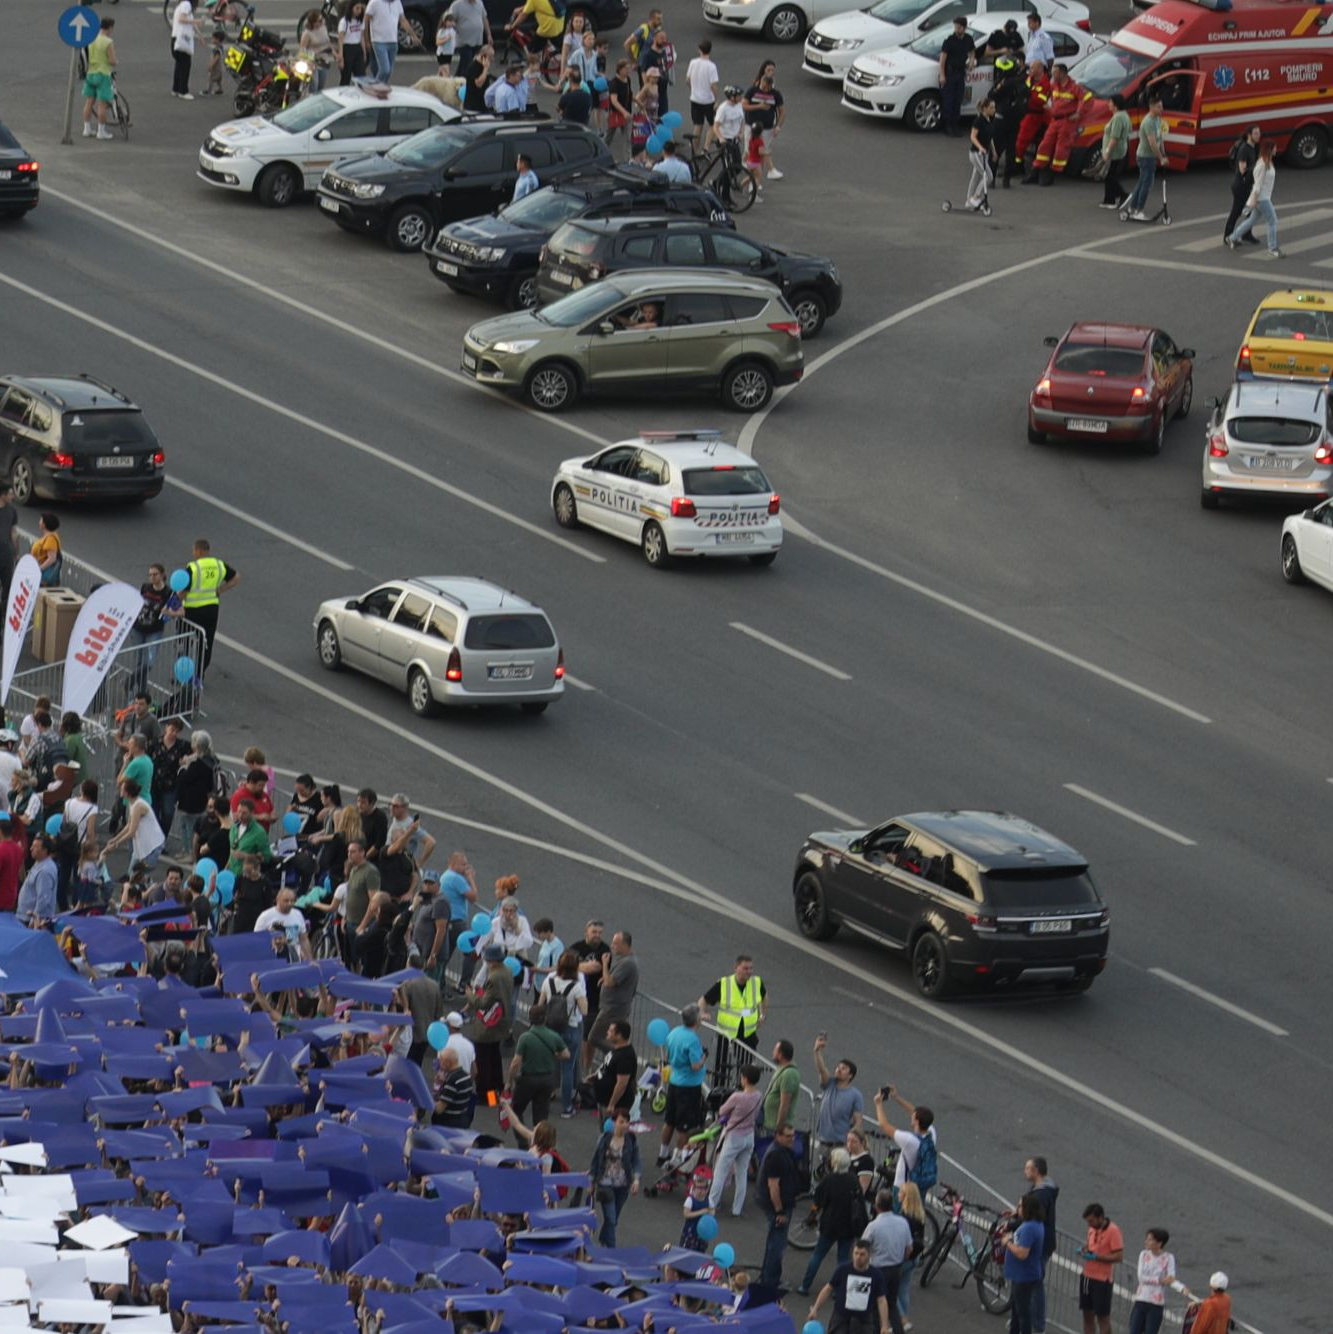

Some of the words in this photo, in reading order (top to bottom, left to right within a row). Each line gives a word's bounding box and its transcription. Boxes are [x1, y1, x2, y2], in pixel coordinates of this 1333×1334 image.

[1208, 33, 1238, 42] ECHIPAJ
[1239, 31, 1257, 39] PRIM
[1258, 29, 1286, 38] AJUTOR
[1251, 68, 1270, 82] 112
[592, 487, 637, 513] POLITIA
[710, 512, 758, 522] POLITIA
[9, 581, 30, 633] bibi
[74, 613, 118, 667] bibi
